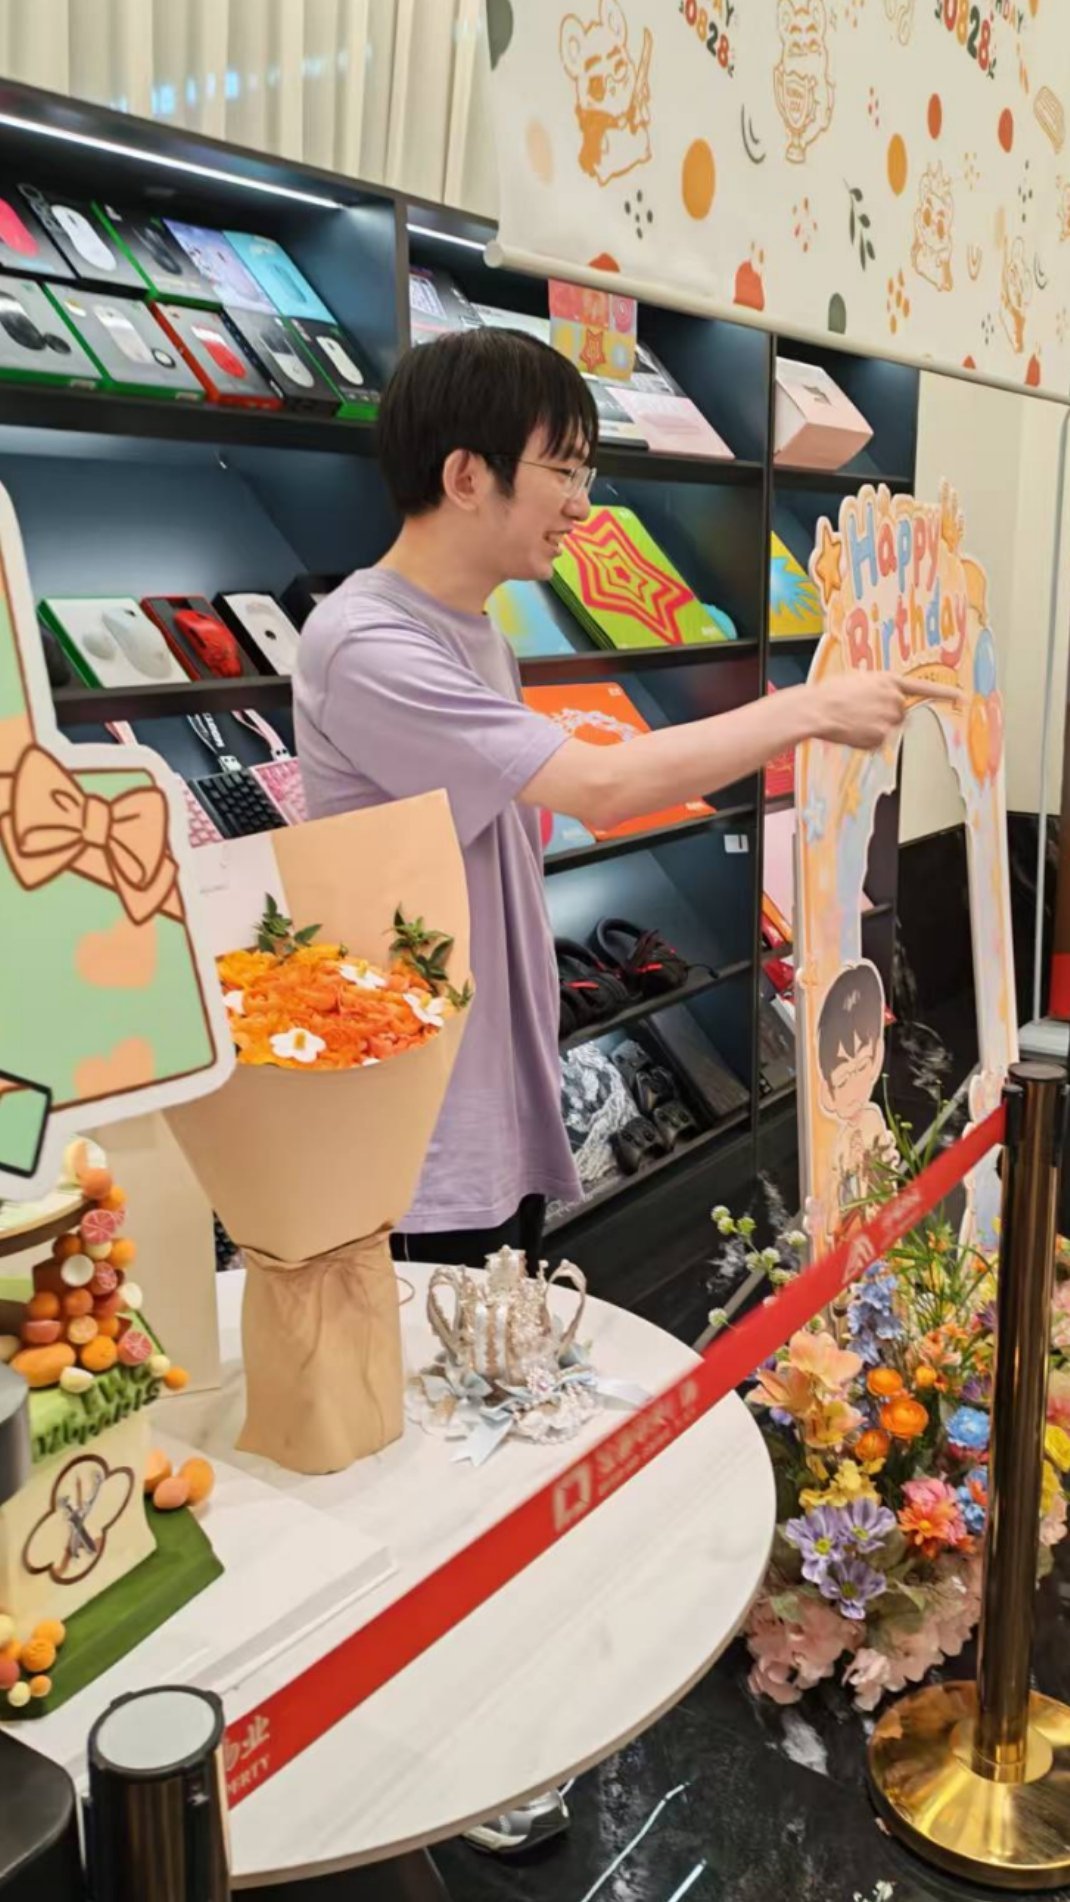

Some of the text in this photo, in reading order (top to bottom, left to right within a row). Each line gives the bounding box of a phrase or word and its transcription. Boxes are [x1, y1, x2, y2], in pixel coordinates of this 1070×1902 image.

[684, 0, 729, 68] 0828
[943, 0, 991, 71] 0828
[849, 501, 940, 601] Happy
[846, 577, 967, 672] Birthday
